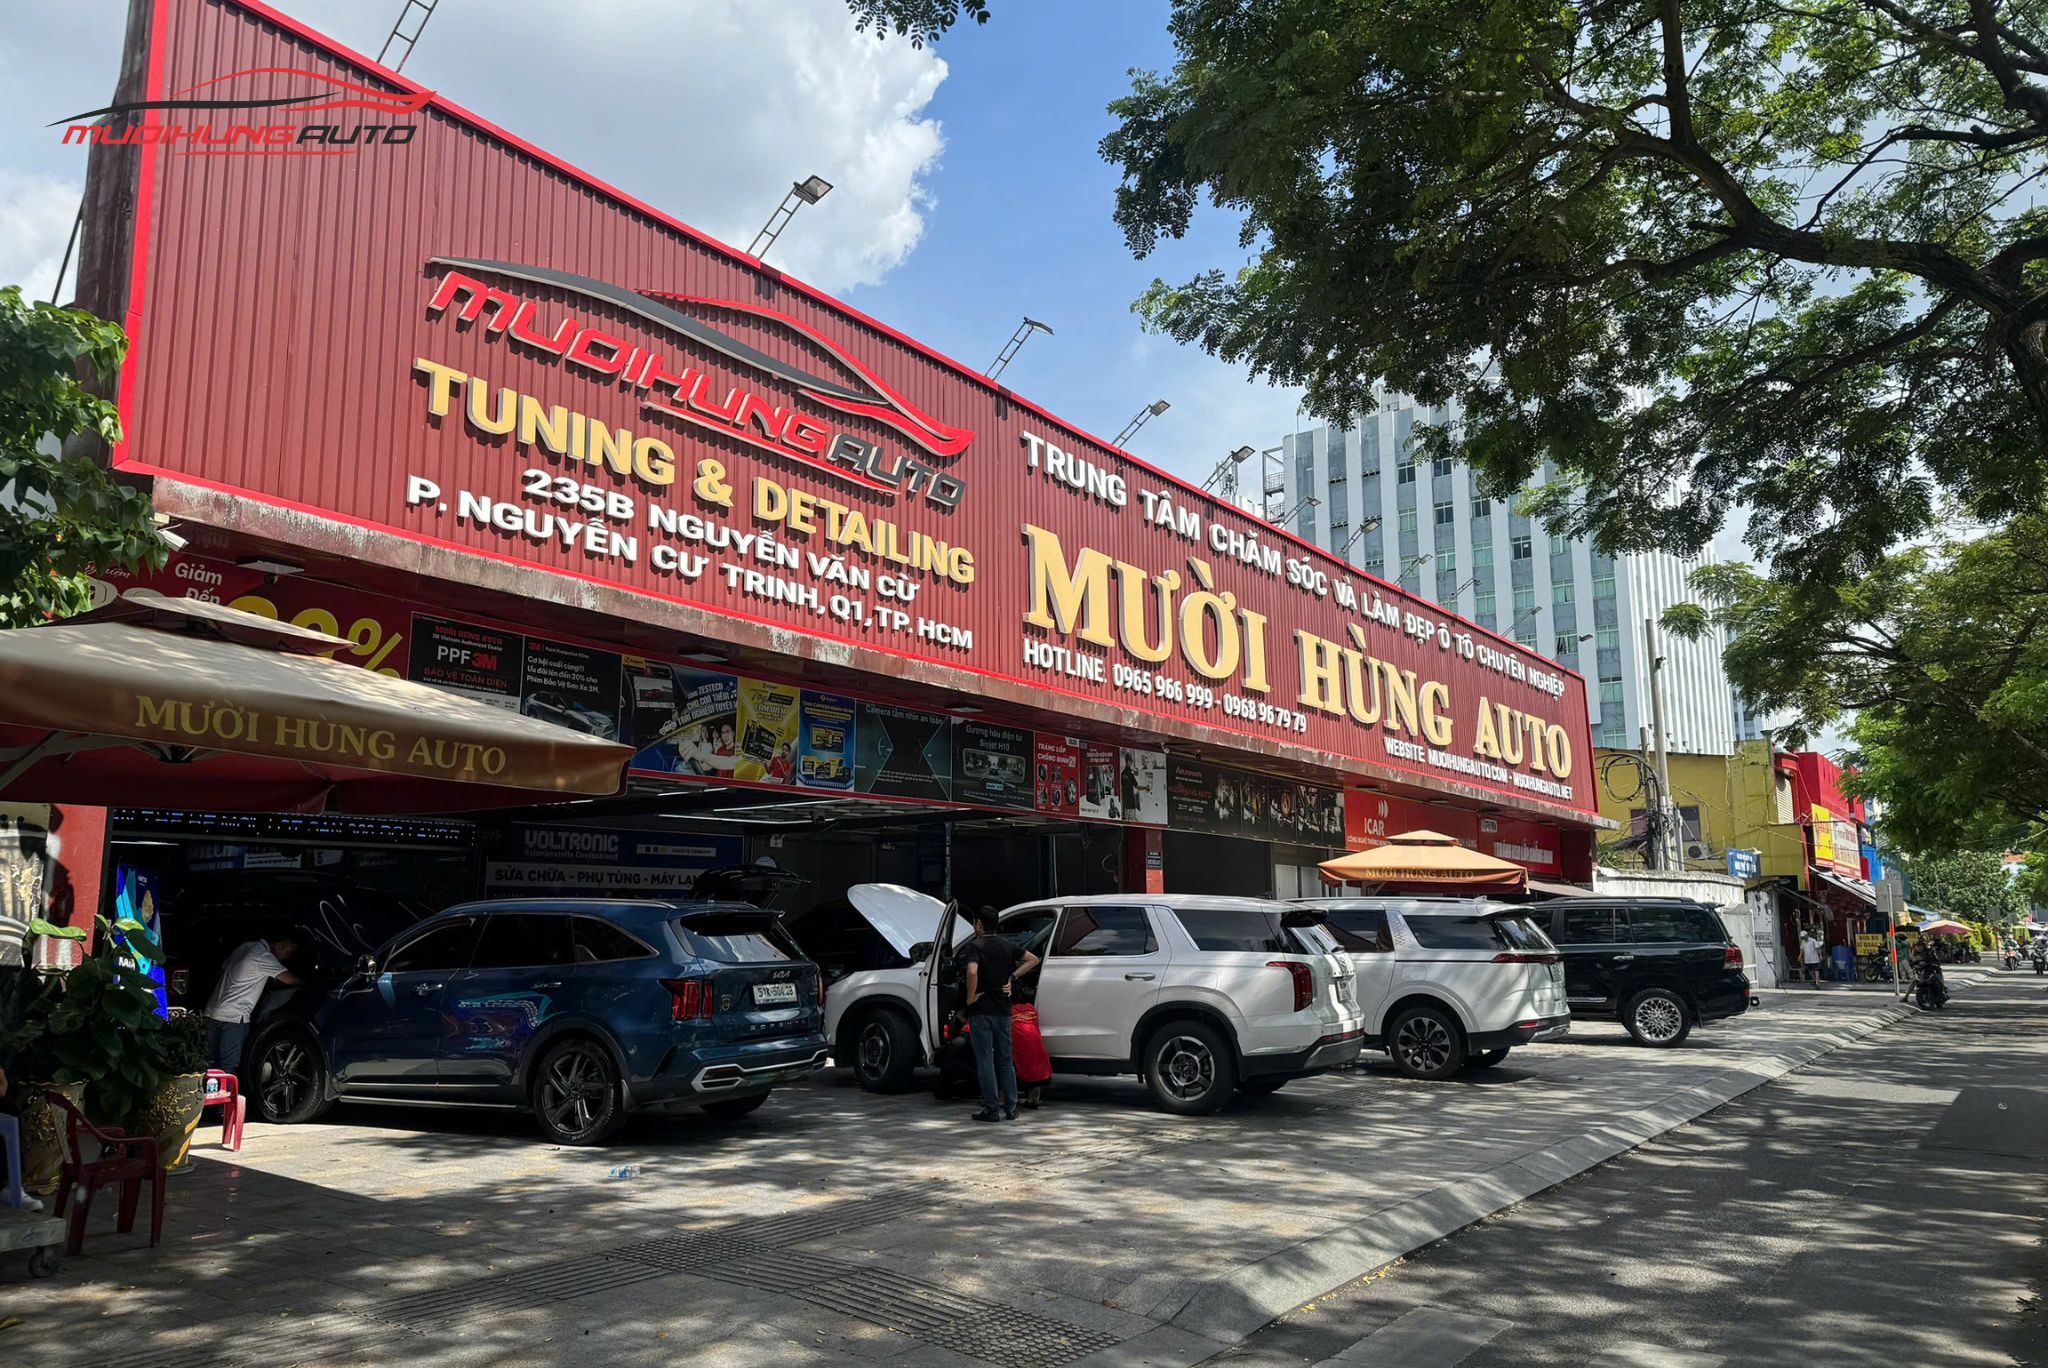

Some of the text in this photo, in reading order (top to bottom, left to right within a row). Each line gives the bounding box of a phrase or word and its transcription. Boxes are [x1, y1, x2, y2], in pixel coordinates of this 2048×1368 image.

[413, 356, 976, 583] TUNING & DETAILING
[407, 474, 447, 513] P.
[457, 493, 638, 562] NGUYỄN
[651, 544, 709, 578] CƯ
[523, 467, 920, 601] 235B NGUYỄN VĂN CỪ
[175, 561, 223, 586] Giảm
[1020, 430, 1565, 701] TRUNG TÂM CHĂM SÓC VÀ LÀM ĐẸP Ô TÔ CHUYÊN NGHIỆP
[437, 644, 497, 671] PPF 3M
[1021, 523, 1574, 780] MƯỜI HÙNG AUTO
[1112, 663, 1152, 695] 0965
[1154, 675, 1183, 702] 966
[1185, 684, 1213, 709] 999
[1223, 693, 1257, 721] 0968
[135, 695, 507, 775] MƯỜI HÙNG AUTO
[524, 829, 619, 853] VOLTRONIC
[1364, 817, 1385, 837] ICAR
[495, 864, 524, 881] SỬA
[528, 868, 566, 882] CHỮA
[577, 870, 604, 886] PHỤ
[607, 870, 640, 885] TÙNG
[651, 871, 676, 885] MÁY
[1365, 865, 1474, 880] MƯỜI HÙNG AUTO
